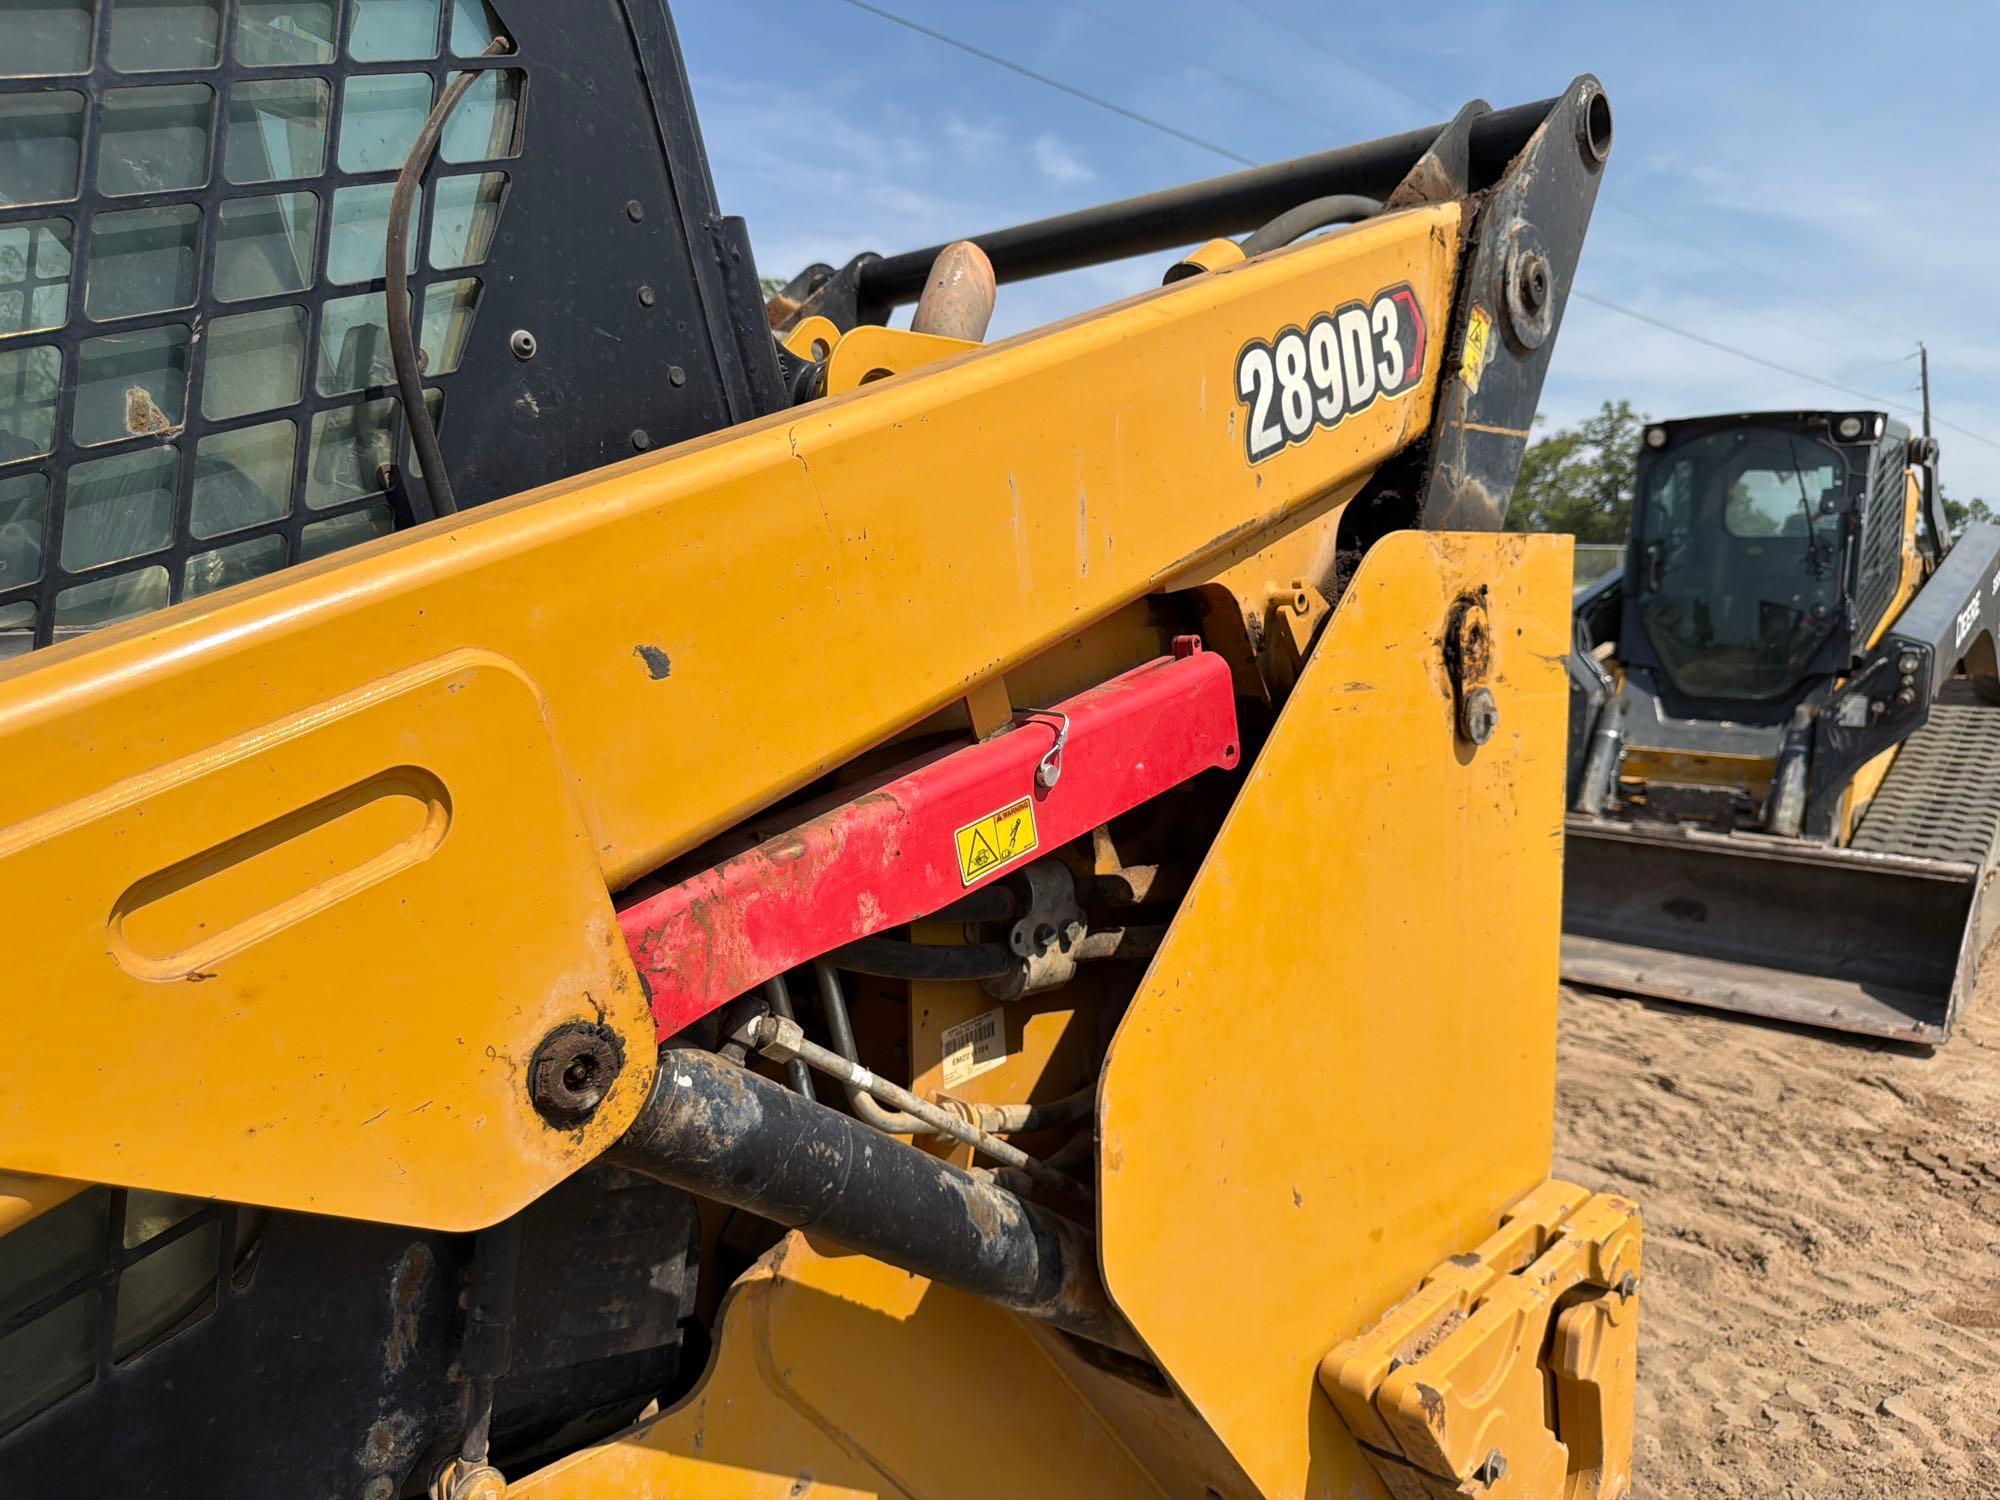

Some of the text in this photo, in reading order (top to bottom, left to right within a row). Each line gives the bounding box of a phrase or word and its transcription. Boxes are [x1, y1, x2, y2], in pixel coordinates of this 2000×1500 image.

[1240, 298, 1404, 455] 289D3
[1955, 588, 1982, 649] DEERE
[1002, 801, 1029, 820] WARNING
